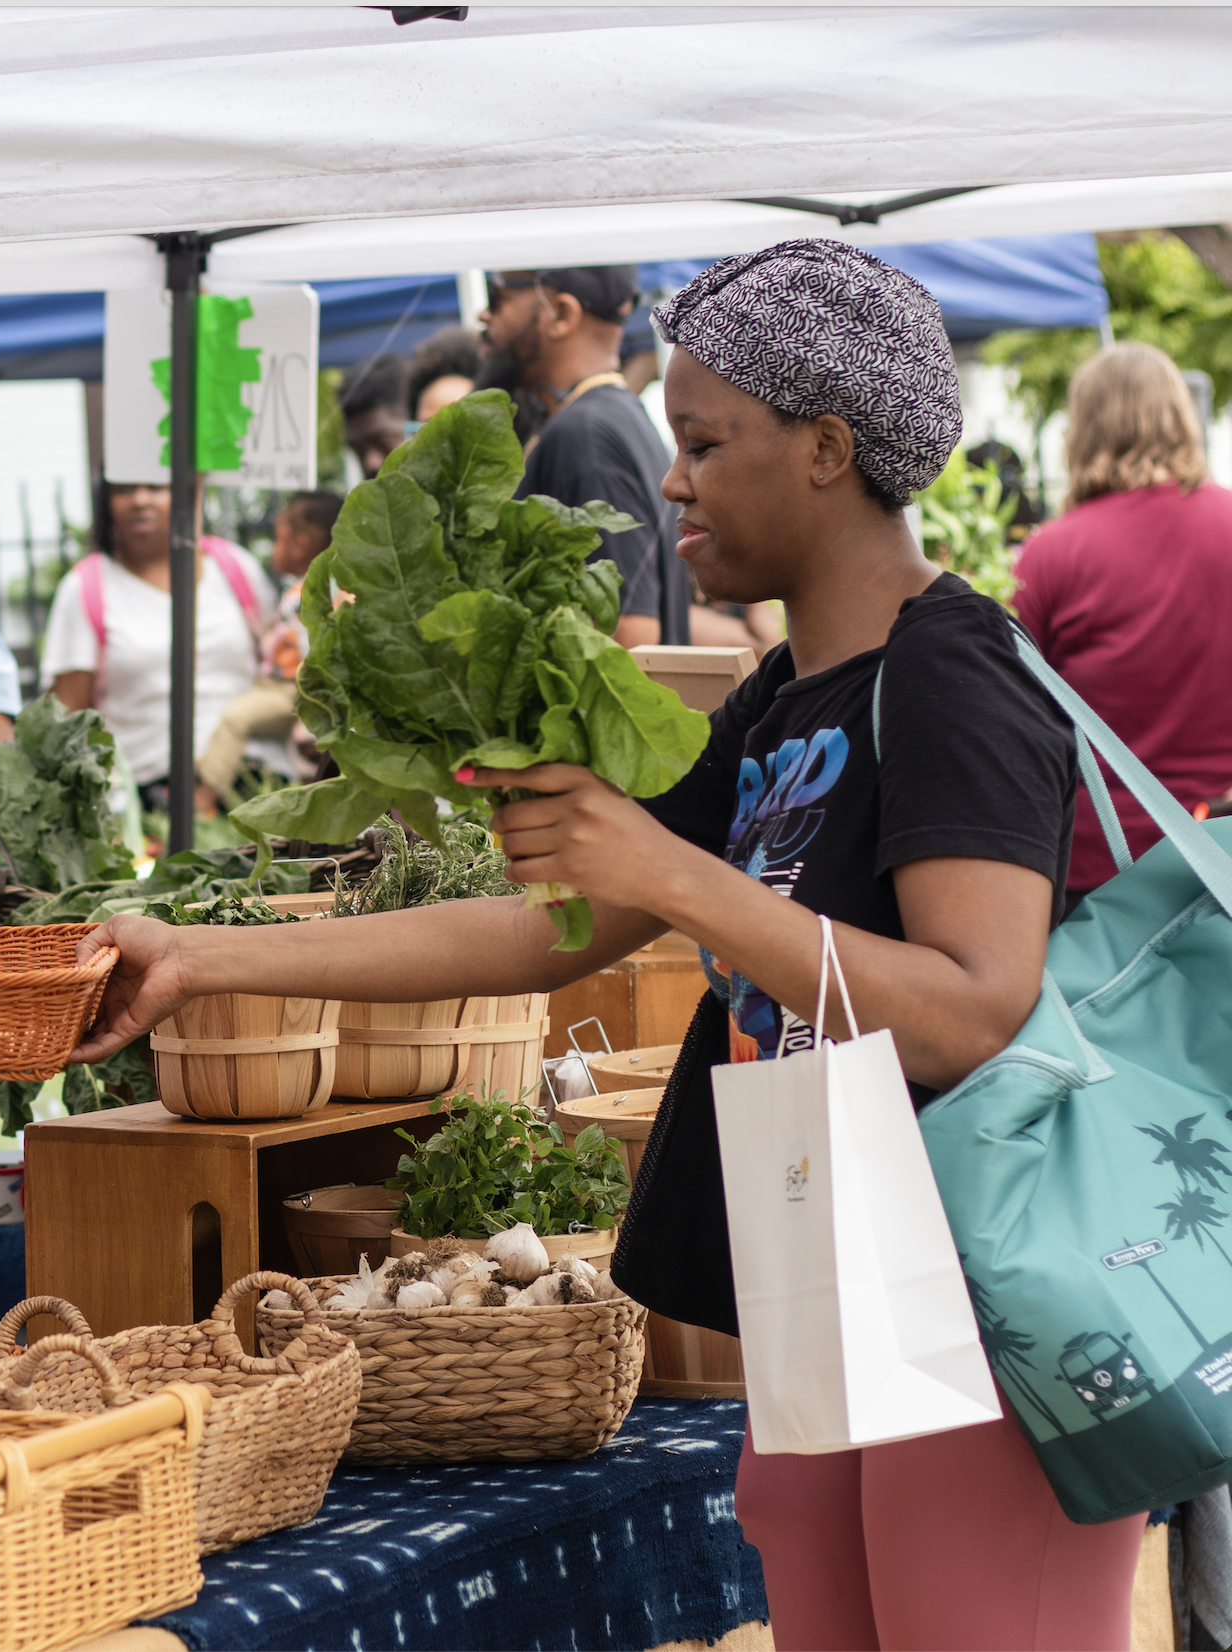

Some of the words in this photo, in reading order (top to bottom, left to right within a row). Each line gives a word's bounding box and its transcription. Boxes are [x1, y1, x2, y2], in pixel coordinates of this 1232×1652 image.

[1112, 1250, 1137, 1264] Arroyo
[1134, 1244, 1156, 1256] Pkwy
[1204, 1357, 1228, 1373] Trader
